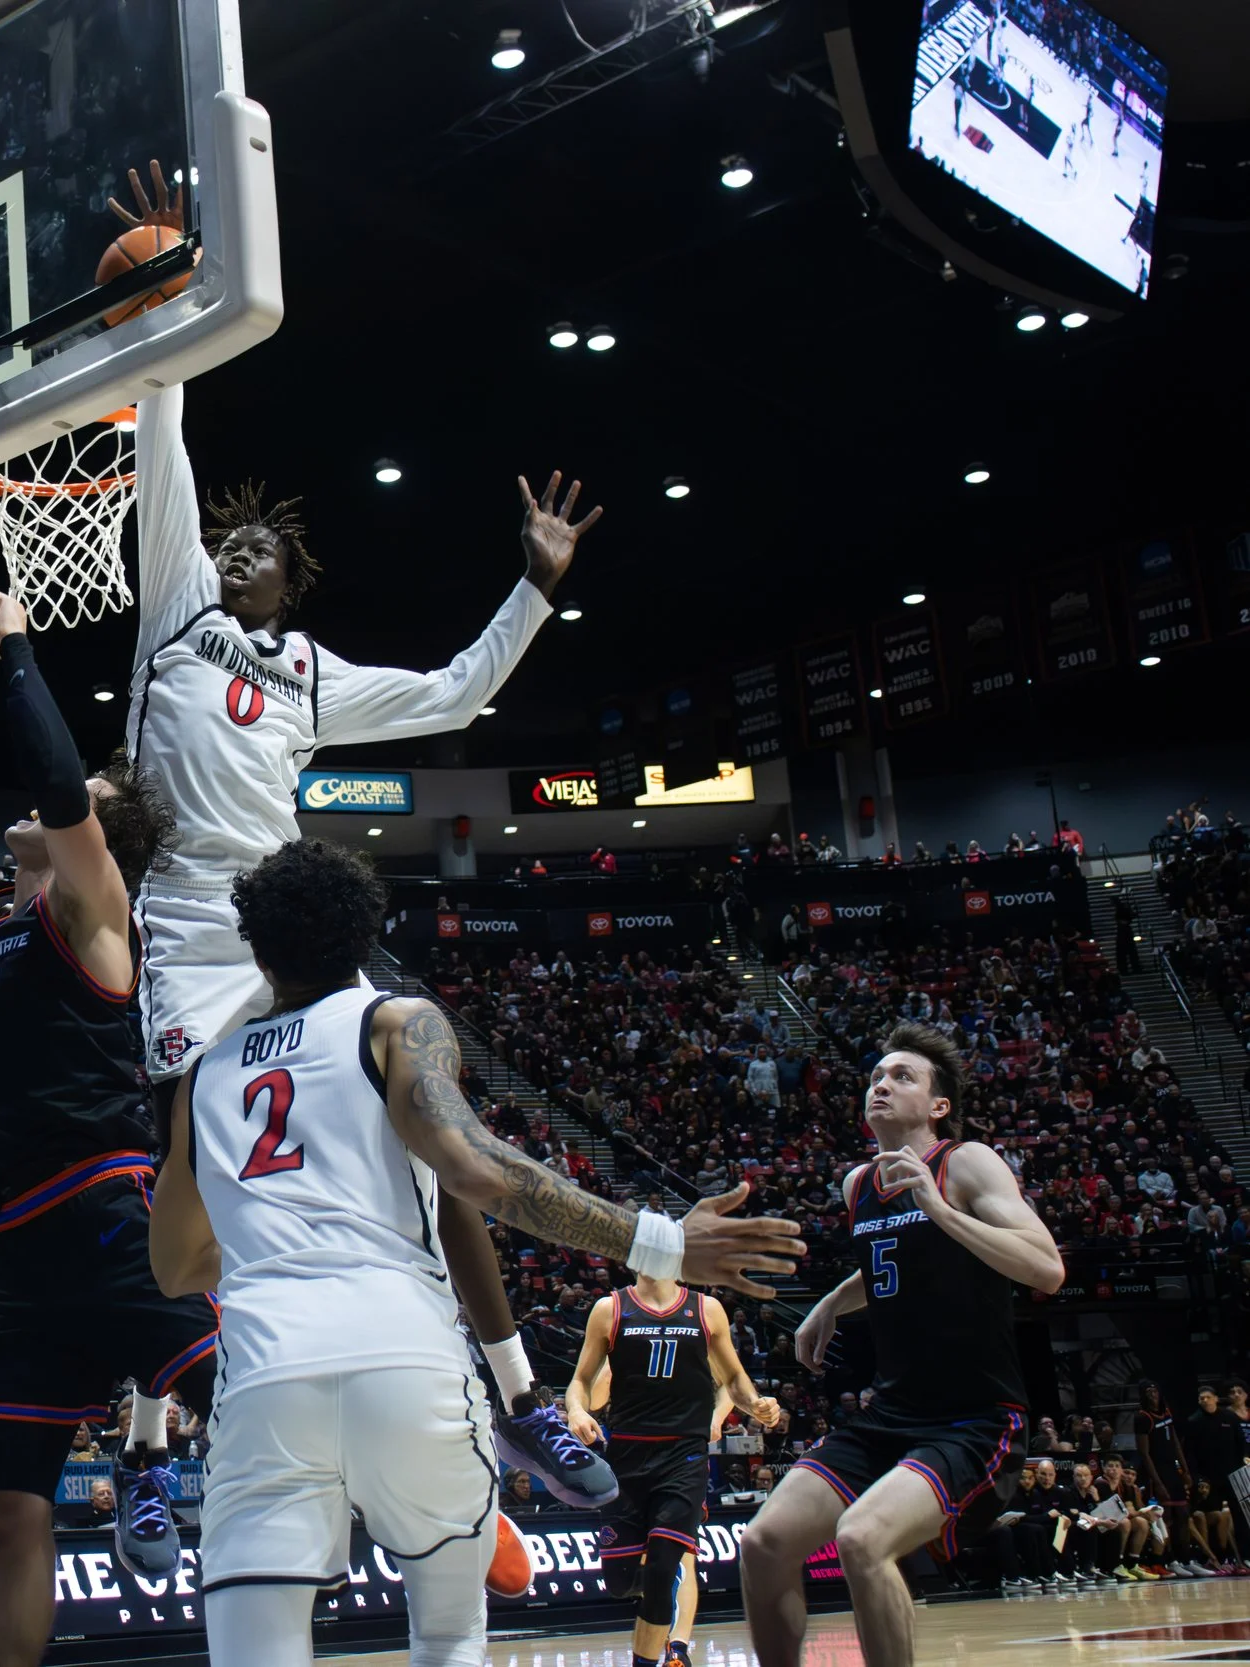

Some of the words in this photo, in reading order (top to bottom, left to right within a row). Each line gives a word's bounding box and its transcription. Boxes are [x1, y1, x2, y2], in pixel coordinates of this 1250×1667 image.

[916, 28, 965, 86] DIEGO
[1149, 624, 1190, 645] 2010
[883, 639, 931, 664] WAC
[1058, 648, 1098, 669] 2010
[195, 630, 229, 666] SAN
[227, 645, 268, 686] DIEGO
[267, 671, 303, 707] STATE
[806, 662, 851, 686] WAC
[226, 676, 264, 726] 0
[734, 683, 779, 706] WAC
[328, 779, 403, 794] CALIFORNIA
[338, 793, 382, 805] COAST
[994, 891, 1056, 907] TOYOTA
[616, 915, 674, 929] TOYOTA
[835, 905, 882, 919] TOYOT
[464, 920, 519, 933] TOYOTA
[241, 1018, 304, 1067] BOYD
[238, 1068, 304, 1181] 2
[853, 1219, 885, 1237] BOISE
[886, 1210, 929, 1229] STATE
[870, 1237, 899, 1299] 5
[623, 1327, 661, 1336] BOISE
[663, 1327, 700, 1337] STATE
[647, 1340, 678, 1378] 11
[64, 1465, 83, 1475] BUD
[85, 1465, 110, 1475] LIGHT
[180, 1464, 198, 1472] BUD
[522, 1532, 602, 1573] BEE
